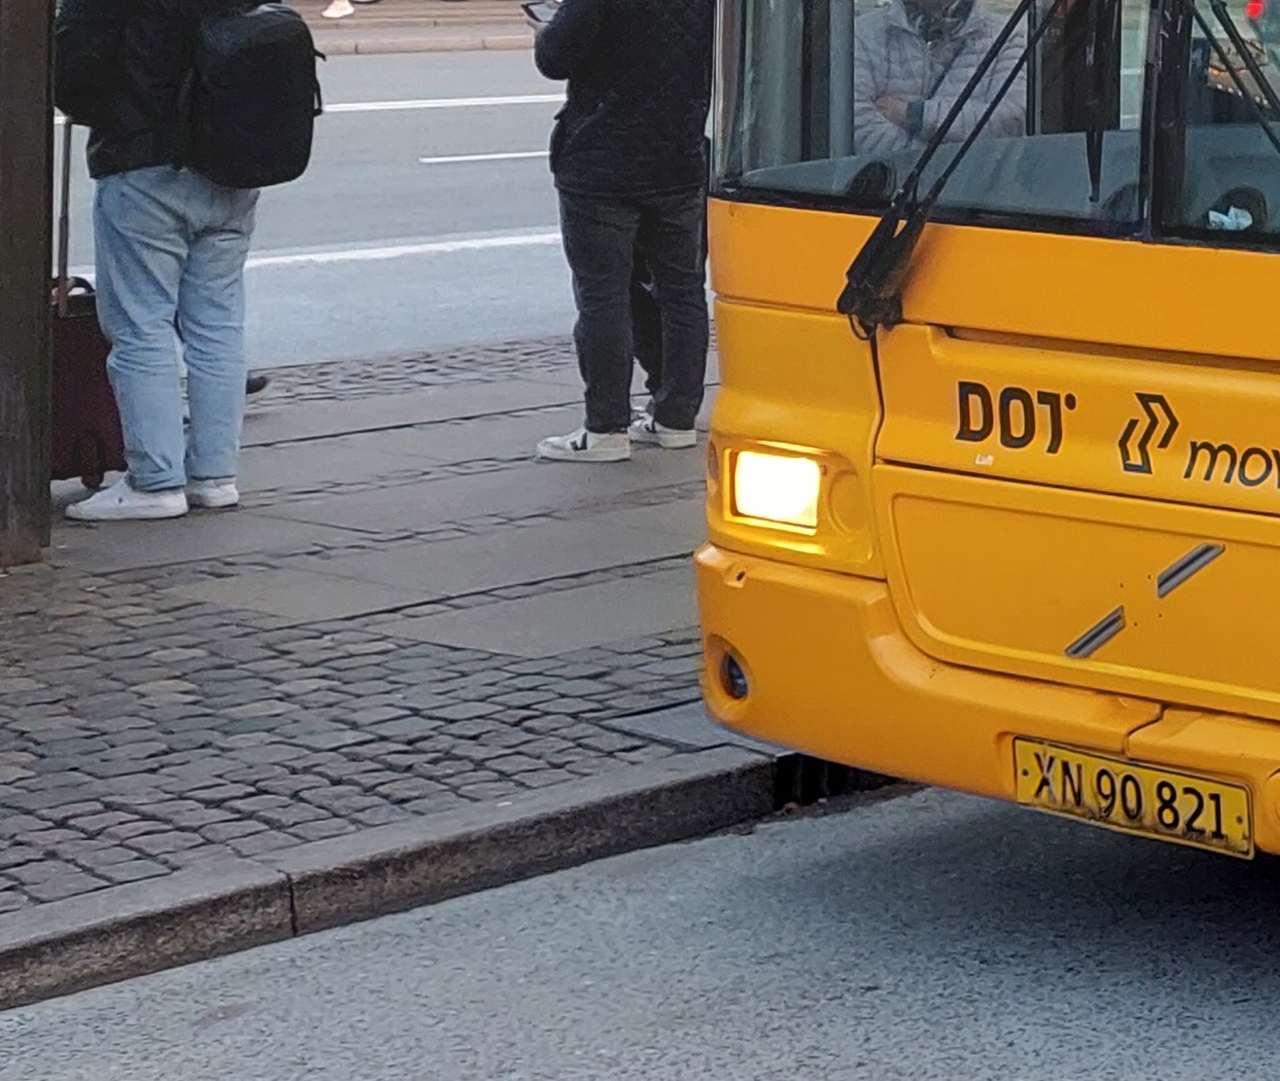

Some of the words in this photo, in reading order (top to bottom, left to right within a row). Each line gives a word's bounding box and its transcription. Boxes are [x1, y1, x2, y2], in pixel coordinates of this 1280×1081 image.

[1034, 751, 1084, 808] XN
[1096, 769, 1143, 821] 90
[1156, 780, 1229, 840] 821
